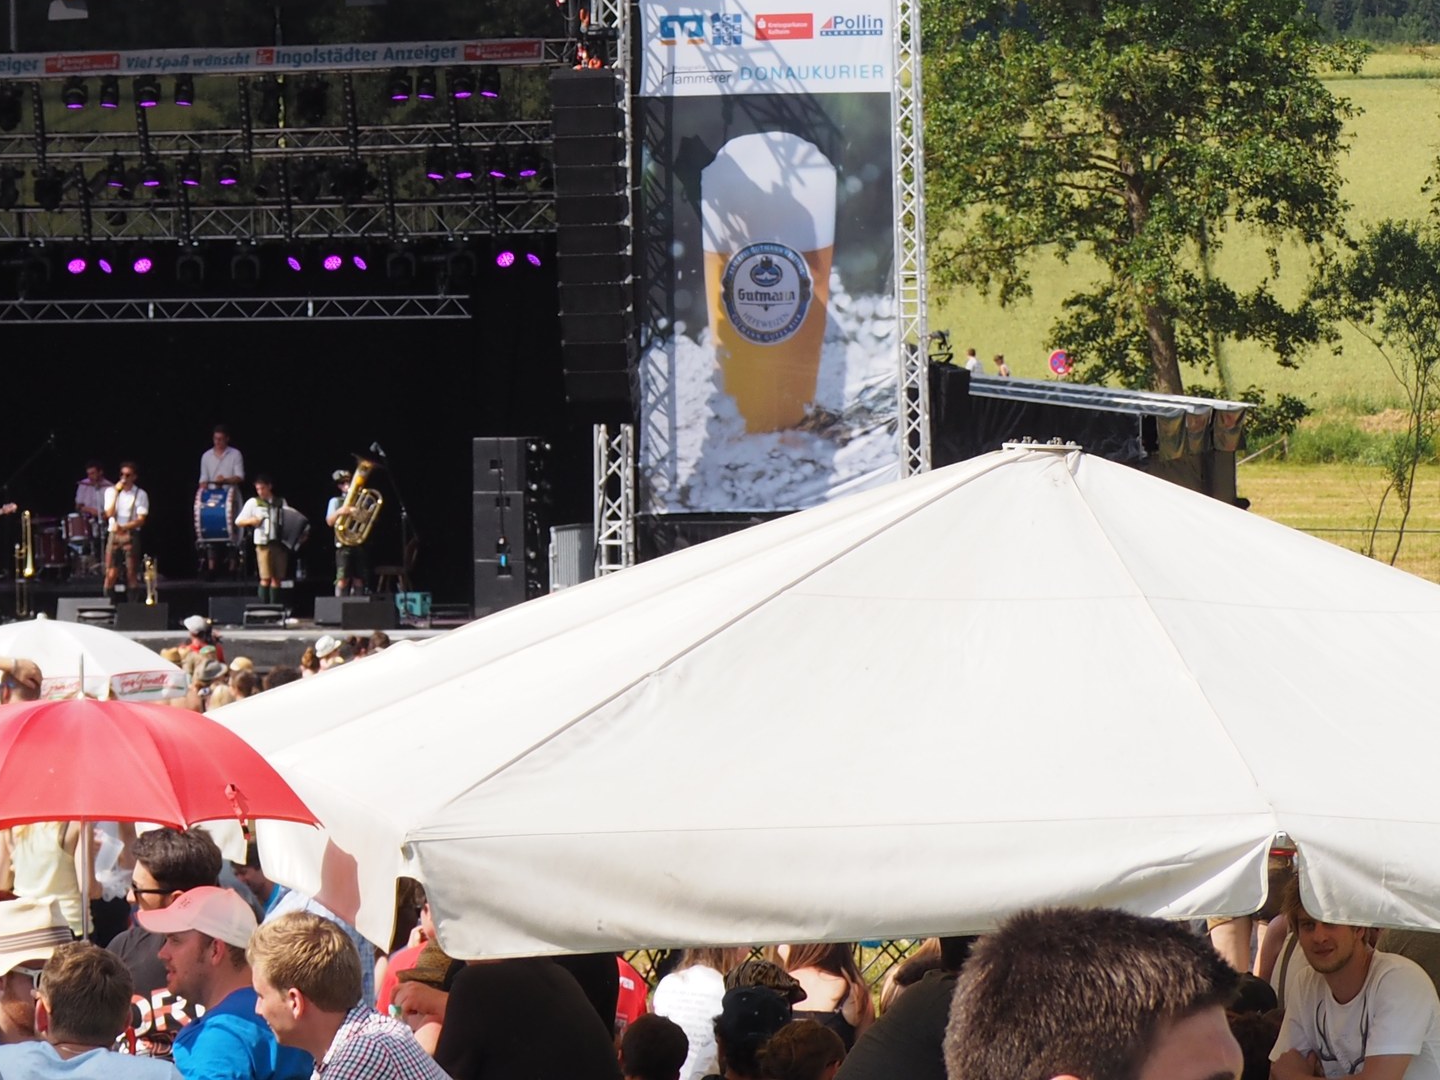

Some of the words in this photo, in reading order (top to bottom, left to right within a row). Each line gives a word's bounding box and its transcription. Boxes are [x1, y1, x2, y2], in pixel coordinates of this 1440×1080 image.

[833, 15, 883, 29] Pollin
[127, 56, 152, 69] Viel
[154, 54, 190, 69] Spaß
[192, 52, 250, 67] wünscht
[275, 45, 378, 67] Ingolstädter
[383, 43, 457, 63] Anzeiger
[740, 64, 884, 81] DONAUKURIER
[738, 288, 796, 302] Gutmann
